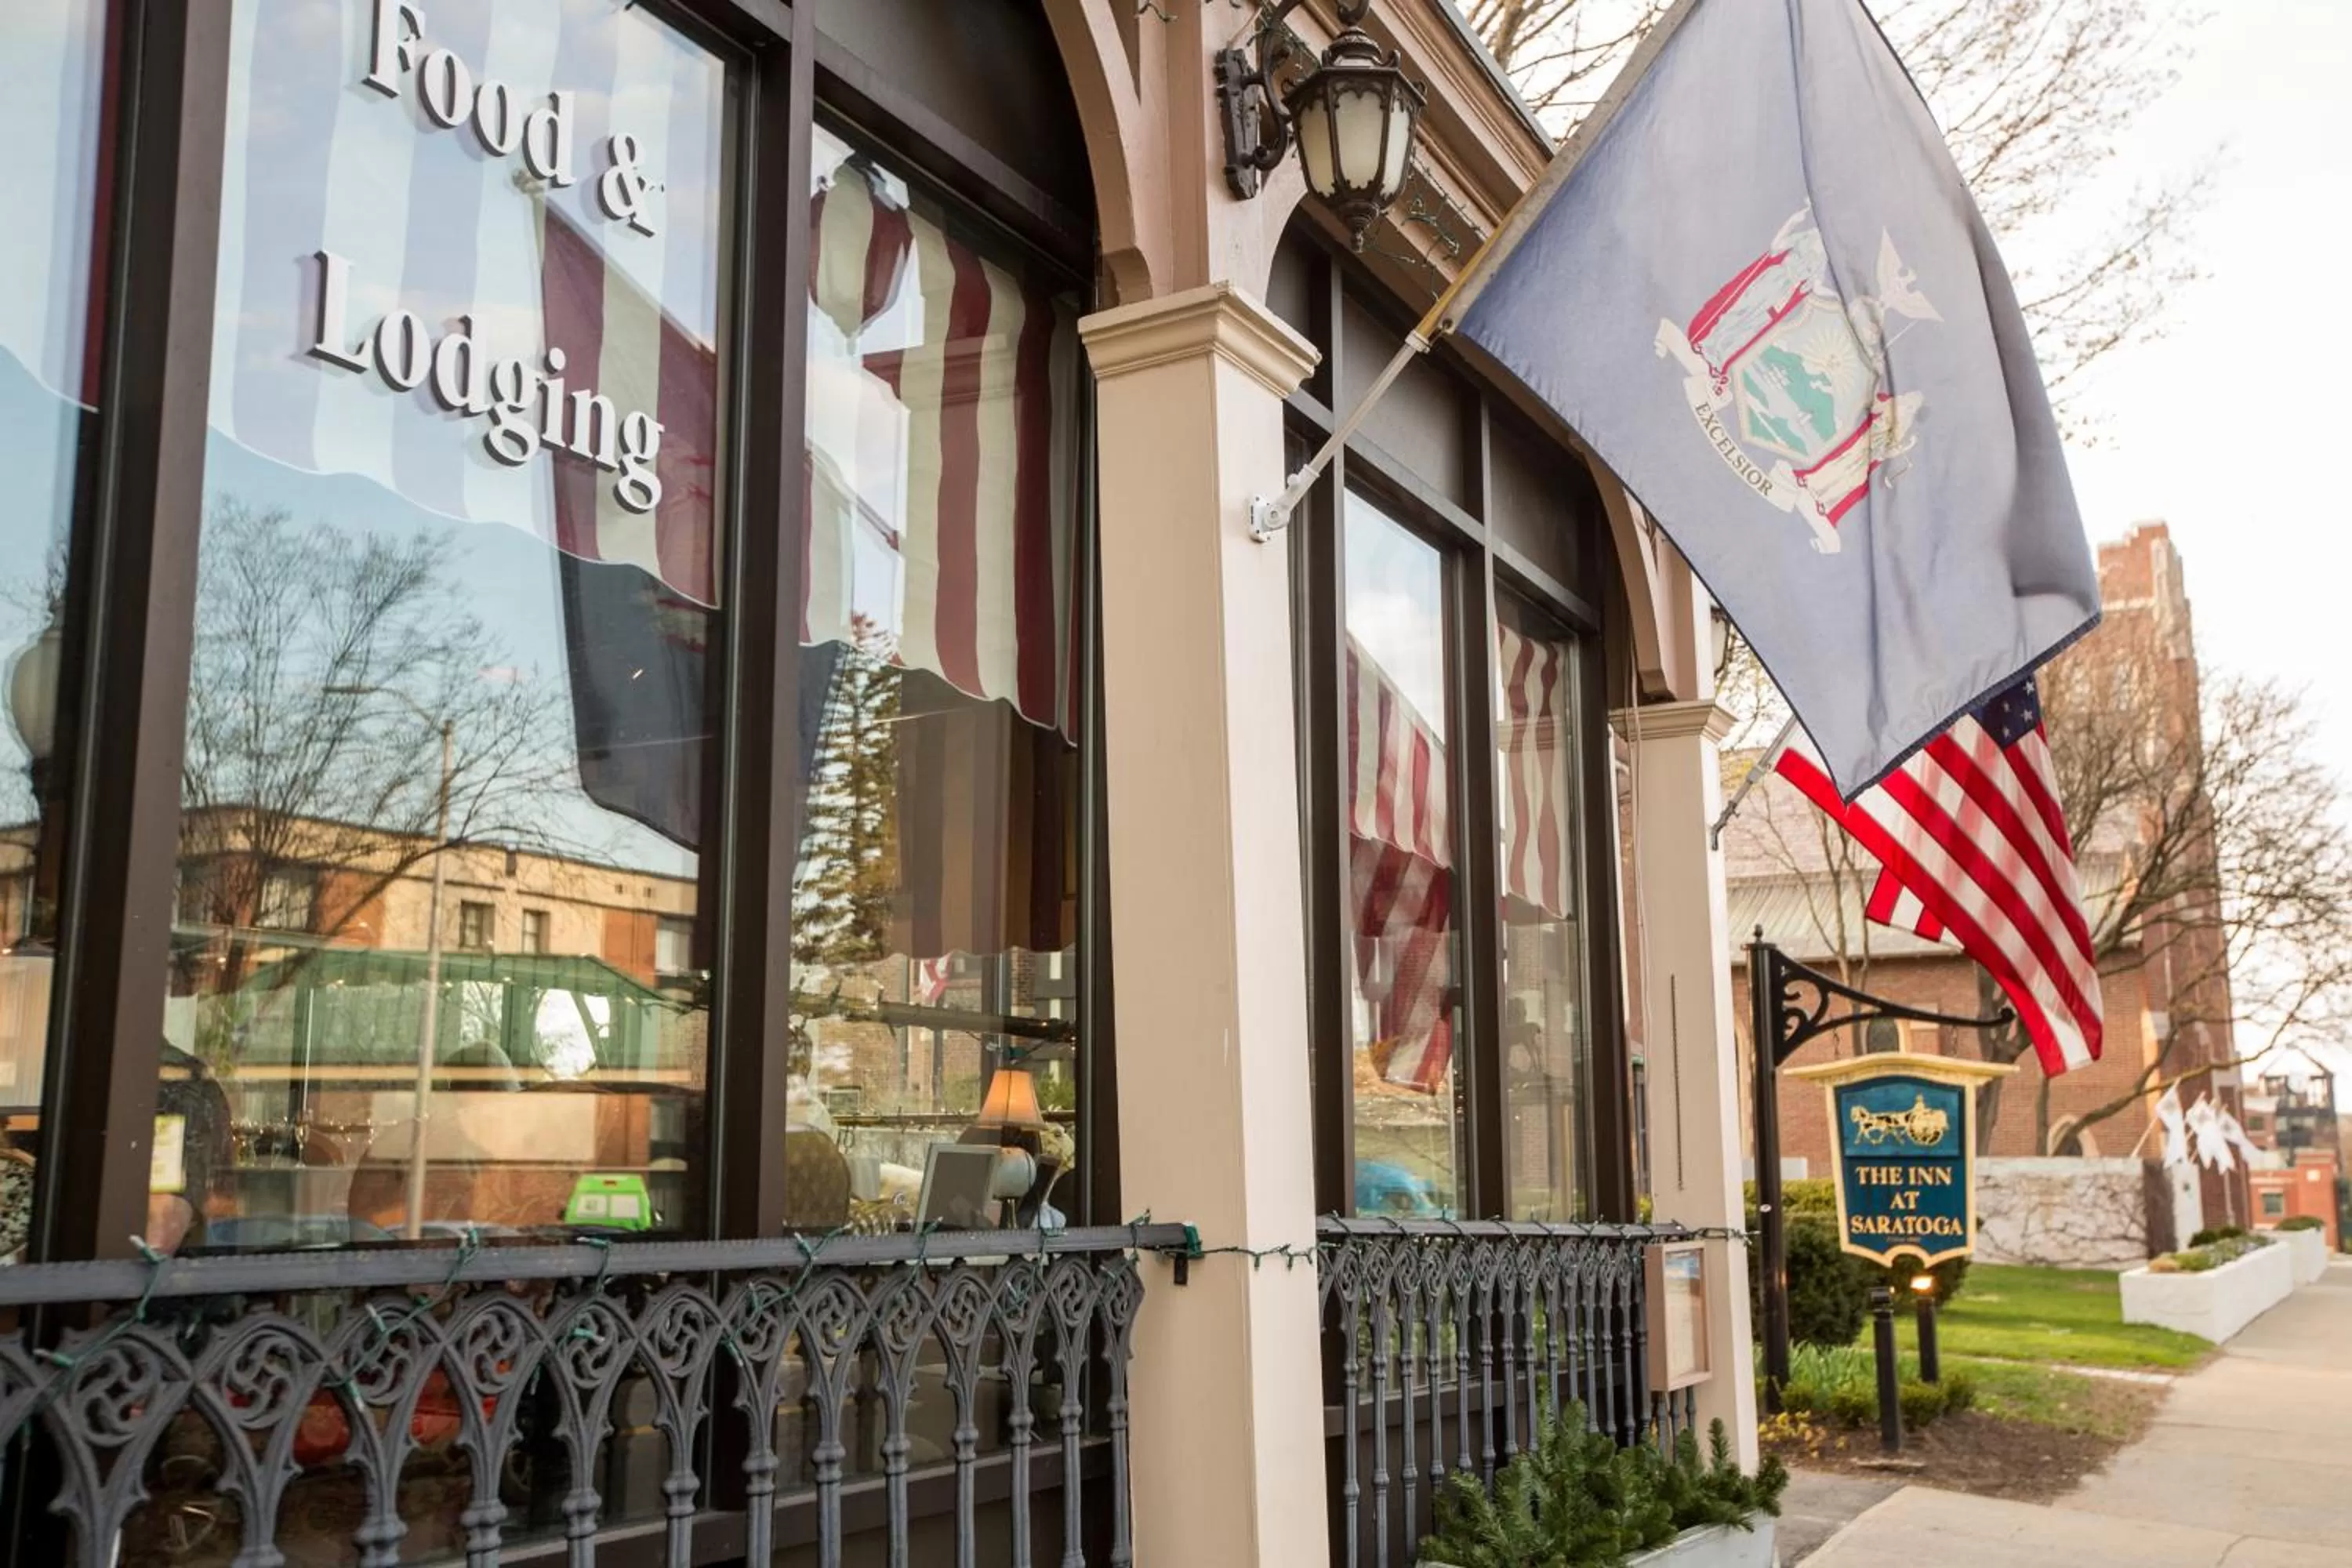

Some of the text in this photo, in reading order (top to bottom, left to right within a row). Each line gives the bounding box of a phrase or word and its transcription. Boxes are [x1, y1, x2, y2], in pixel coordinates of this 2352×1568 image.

[362, 0, 665, 238] Food &
[307, 249, 665, 514] Lodging
[1695, 401, 1773, 496] EXCELSIOR
[1854, 1166, 1952, 1185] THE INN
[1889, 1191, 1920, 1210] AT
[1850, 1215, 1964, 1236] SARATOGA
